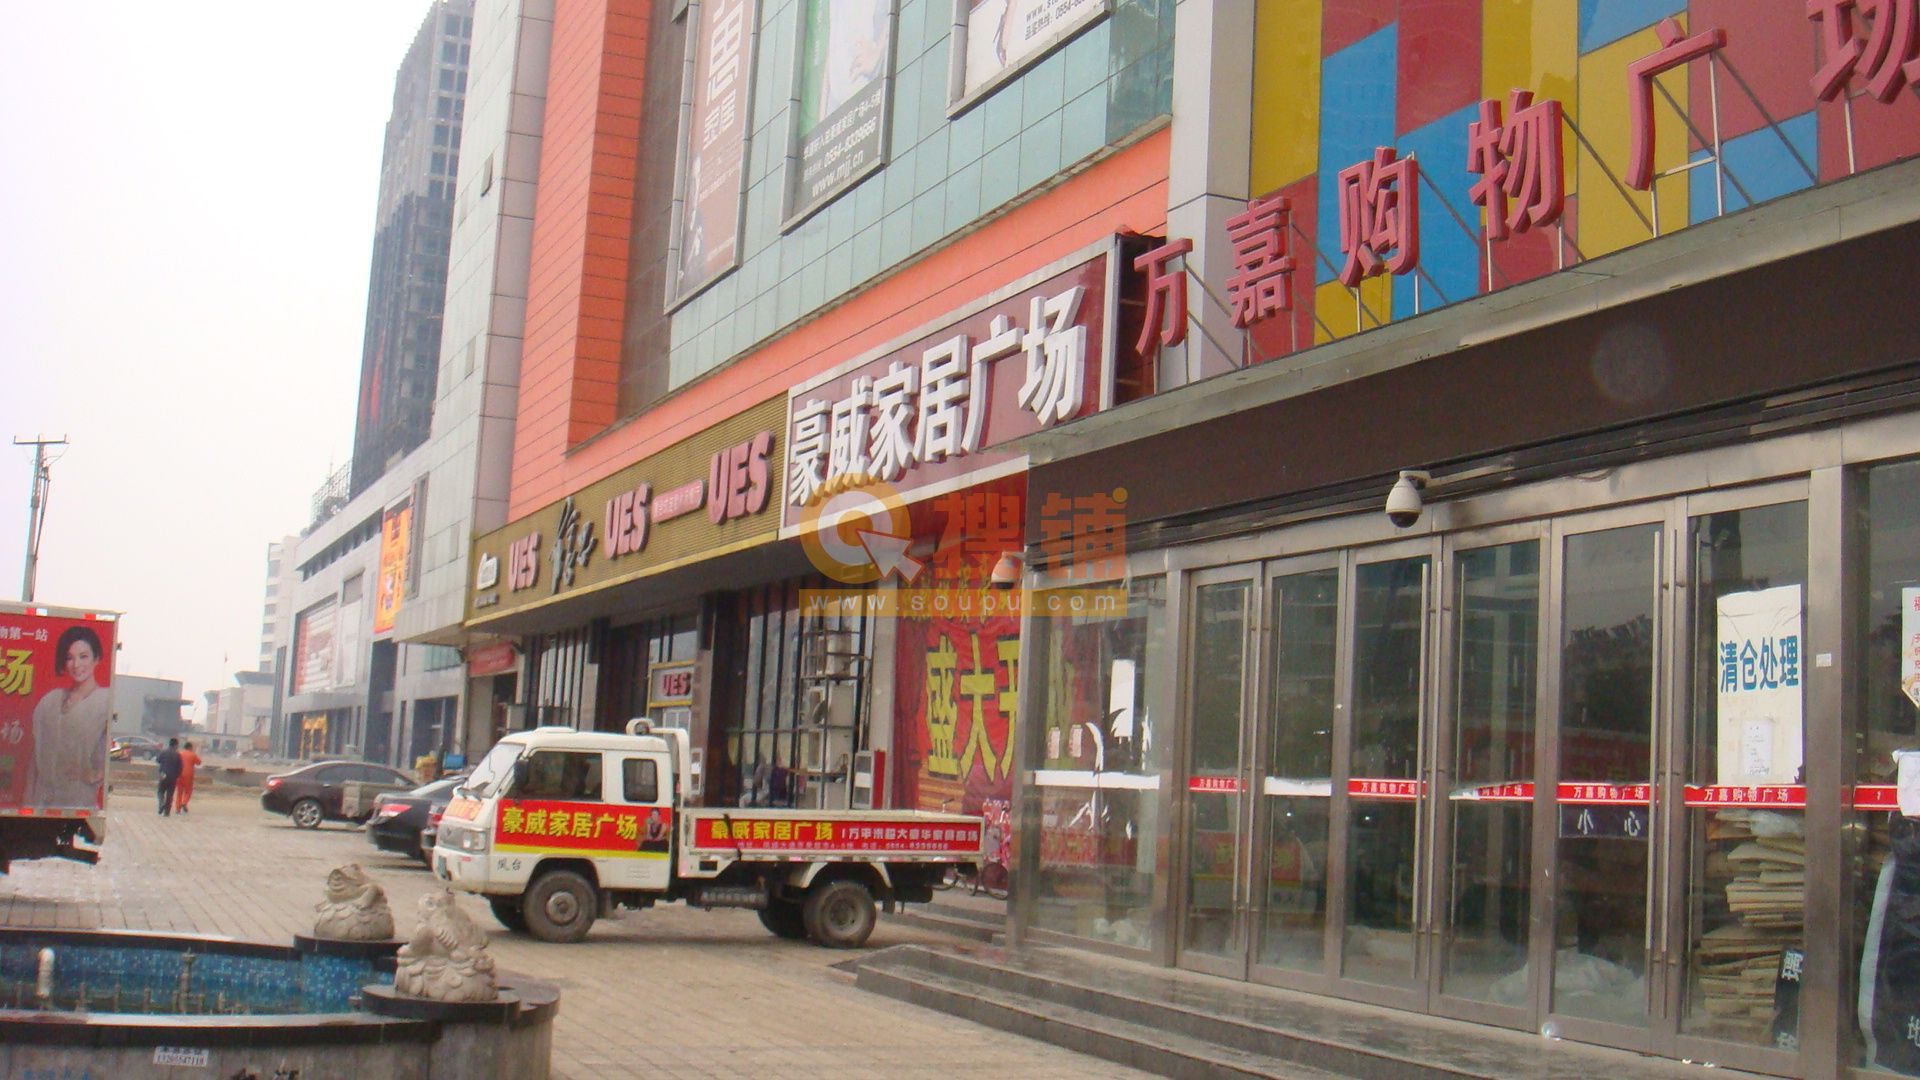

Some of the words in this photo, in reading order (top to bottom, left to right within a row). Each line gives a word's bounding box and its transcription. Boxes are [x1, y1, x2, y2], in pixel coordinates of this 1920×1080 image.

[1133, 0, 1920, 357] 万嘉购物广场
[790, 285, 1087, 508] 豪威家居广场
[708, 430, 774, 524] UES
[604, 483, 651, 559] UES
[507, 532, 541, 592] UES
[662, 671, 691, 697] UES
[1720, 635, 1799, 693] 清仓处理
[1573, 785, 1645, 800] 万嘉购物广场
[502, 806, 638, 841] 豪威家居广场
[711, 820, 834, 842] 豪威家居广场
[1577, 808, 1642, 837] 小心
